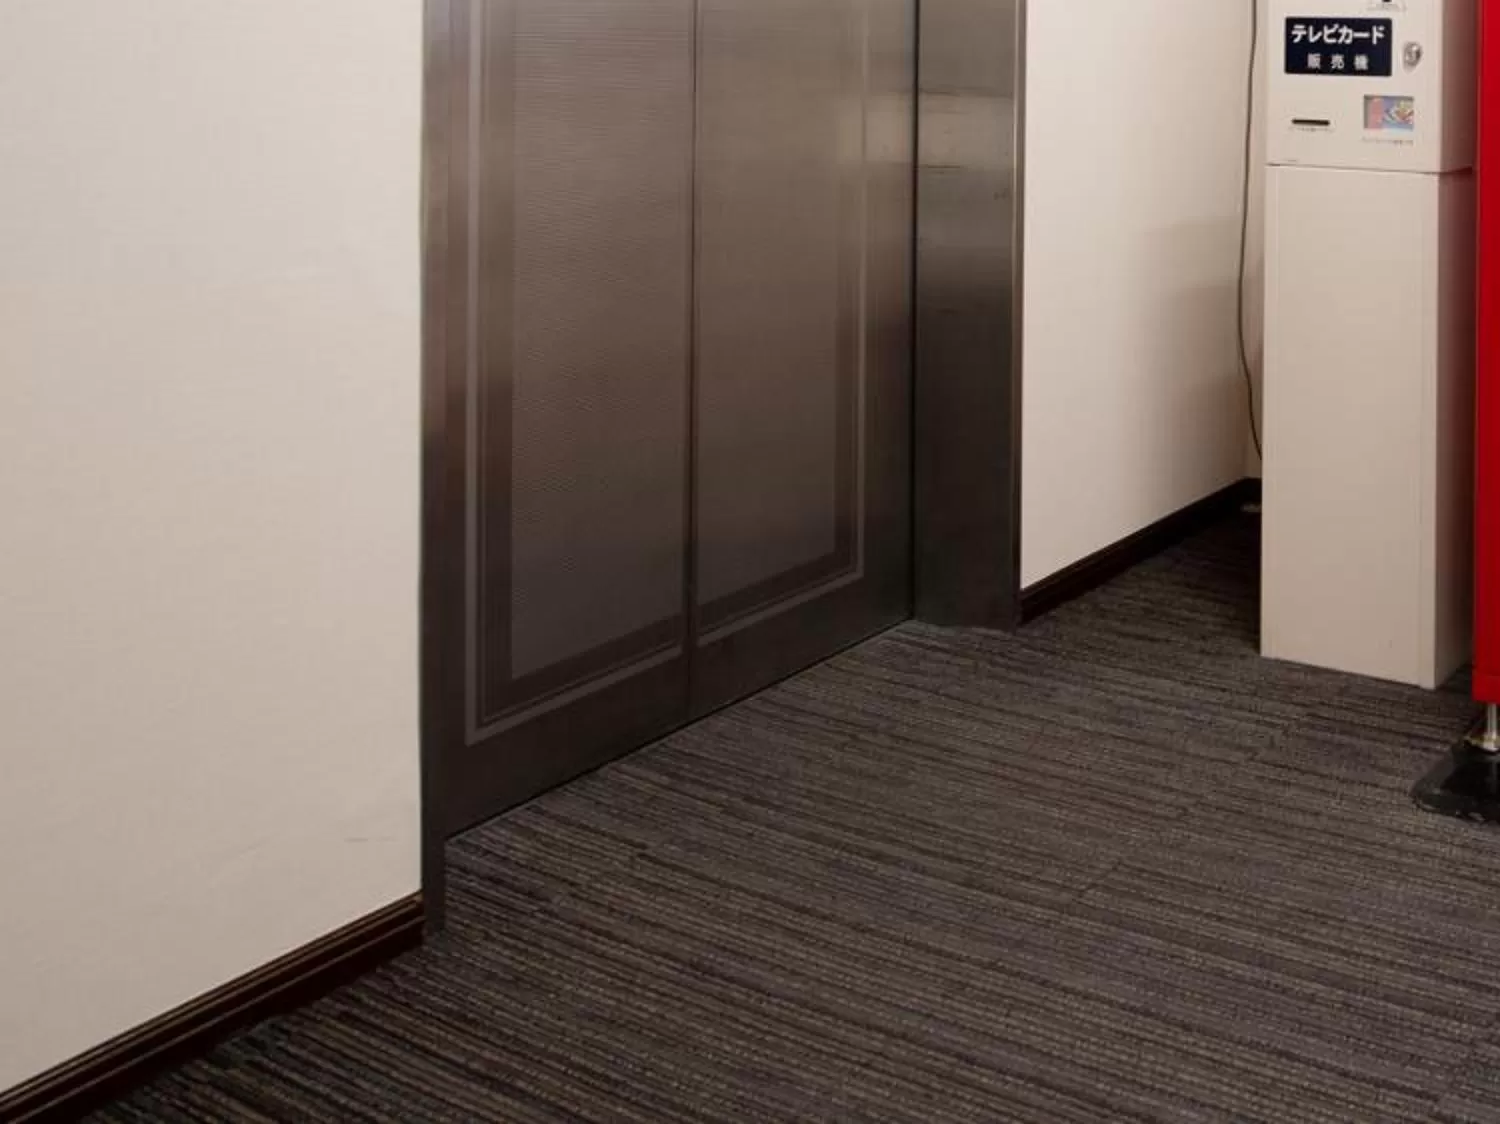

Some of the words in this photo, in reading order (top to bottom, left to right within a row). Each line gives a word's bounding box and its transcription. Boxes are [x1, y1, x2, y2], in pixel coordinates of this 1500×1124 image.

[1290, 23, 1386, 46] テレビカード
